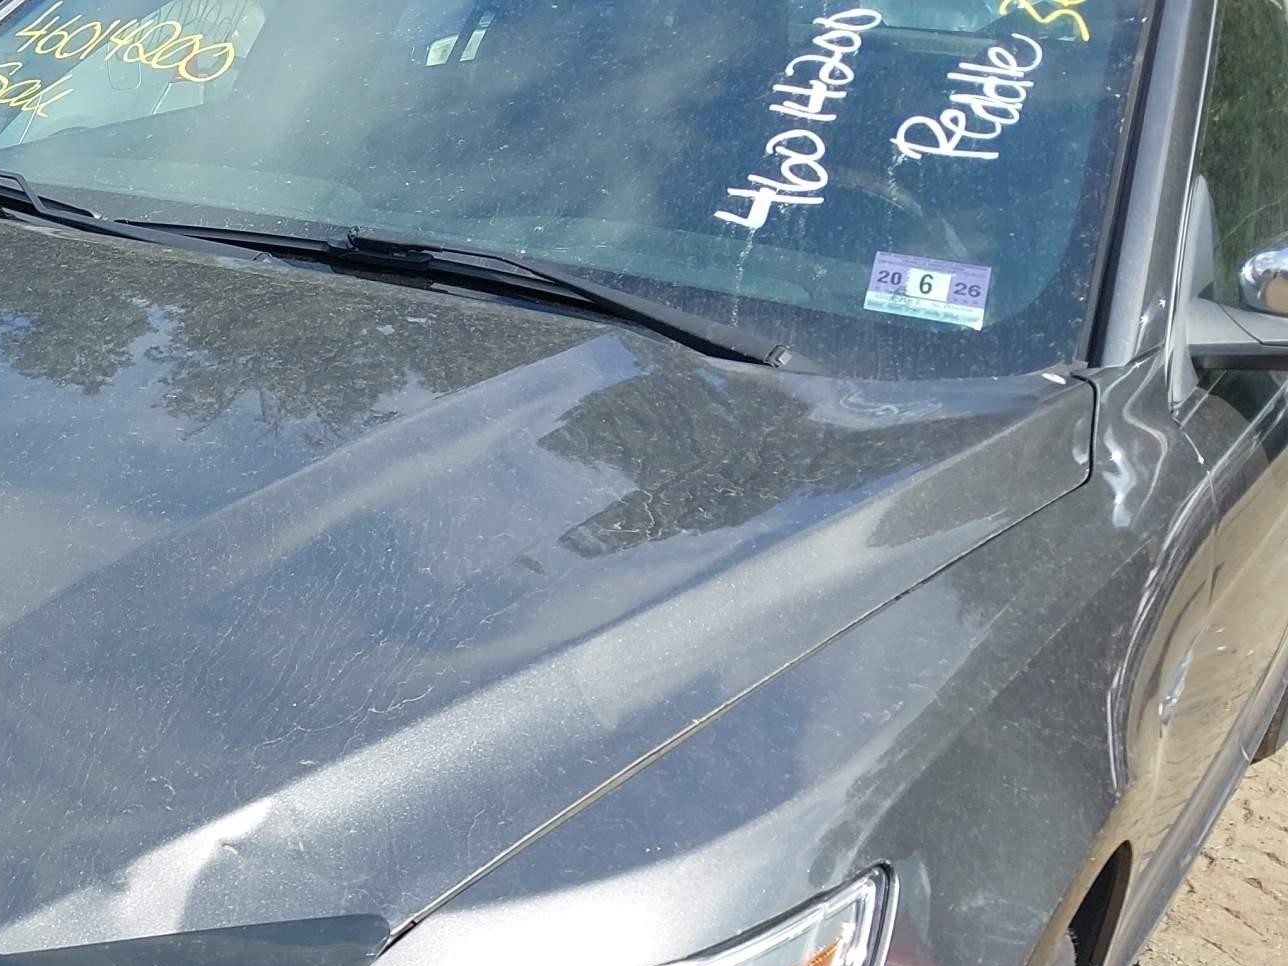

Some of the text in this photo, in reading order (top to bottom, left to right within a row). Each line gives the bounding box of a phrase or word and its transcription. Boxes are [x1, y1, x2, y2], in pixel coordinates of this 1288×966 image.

[16, 0, 235, 82] 46014200
[713, 7, 883, 229] 46014200
[877, 270, 982, 298] 20 6 26
